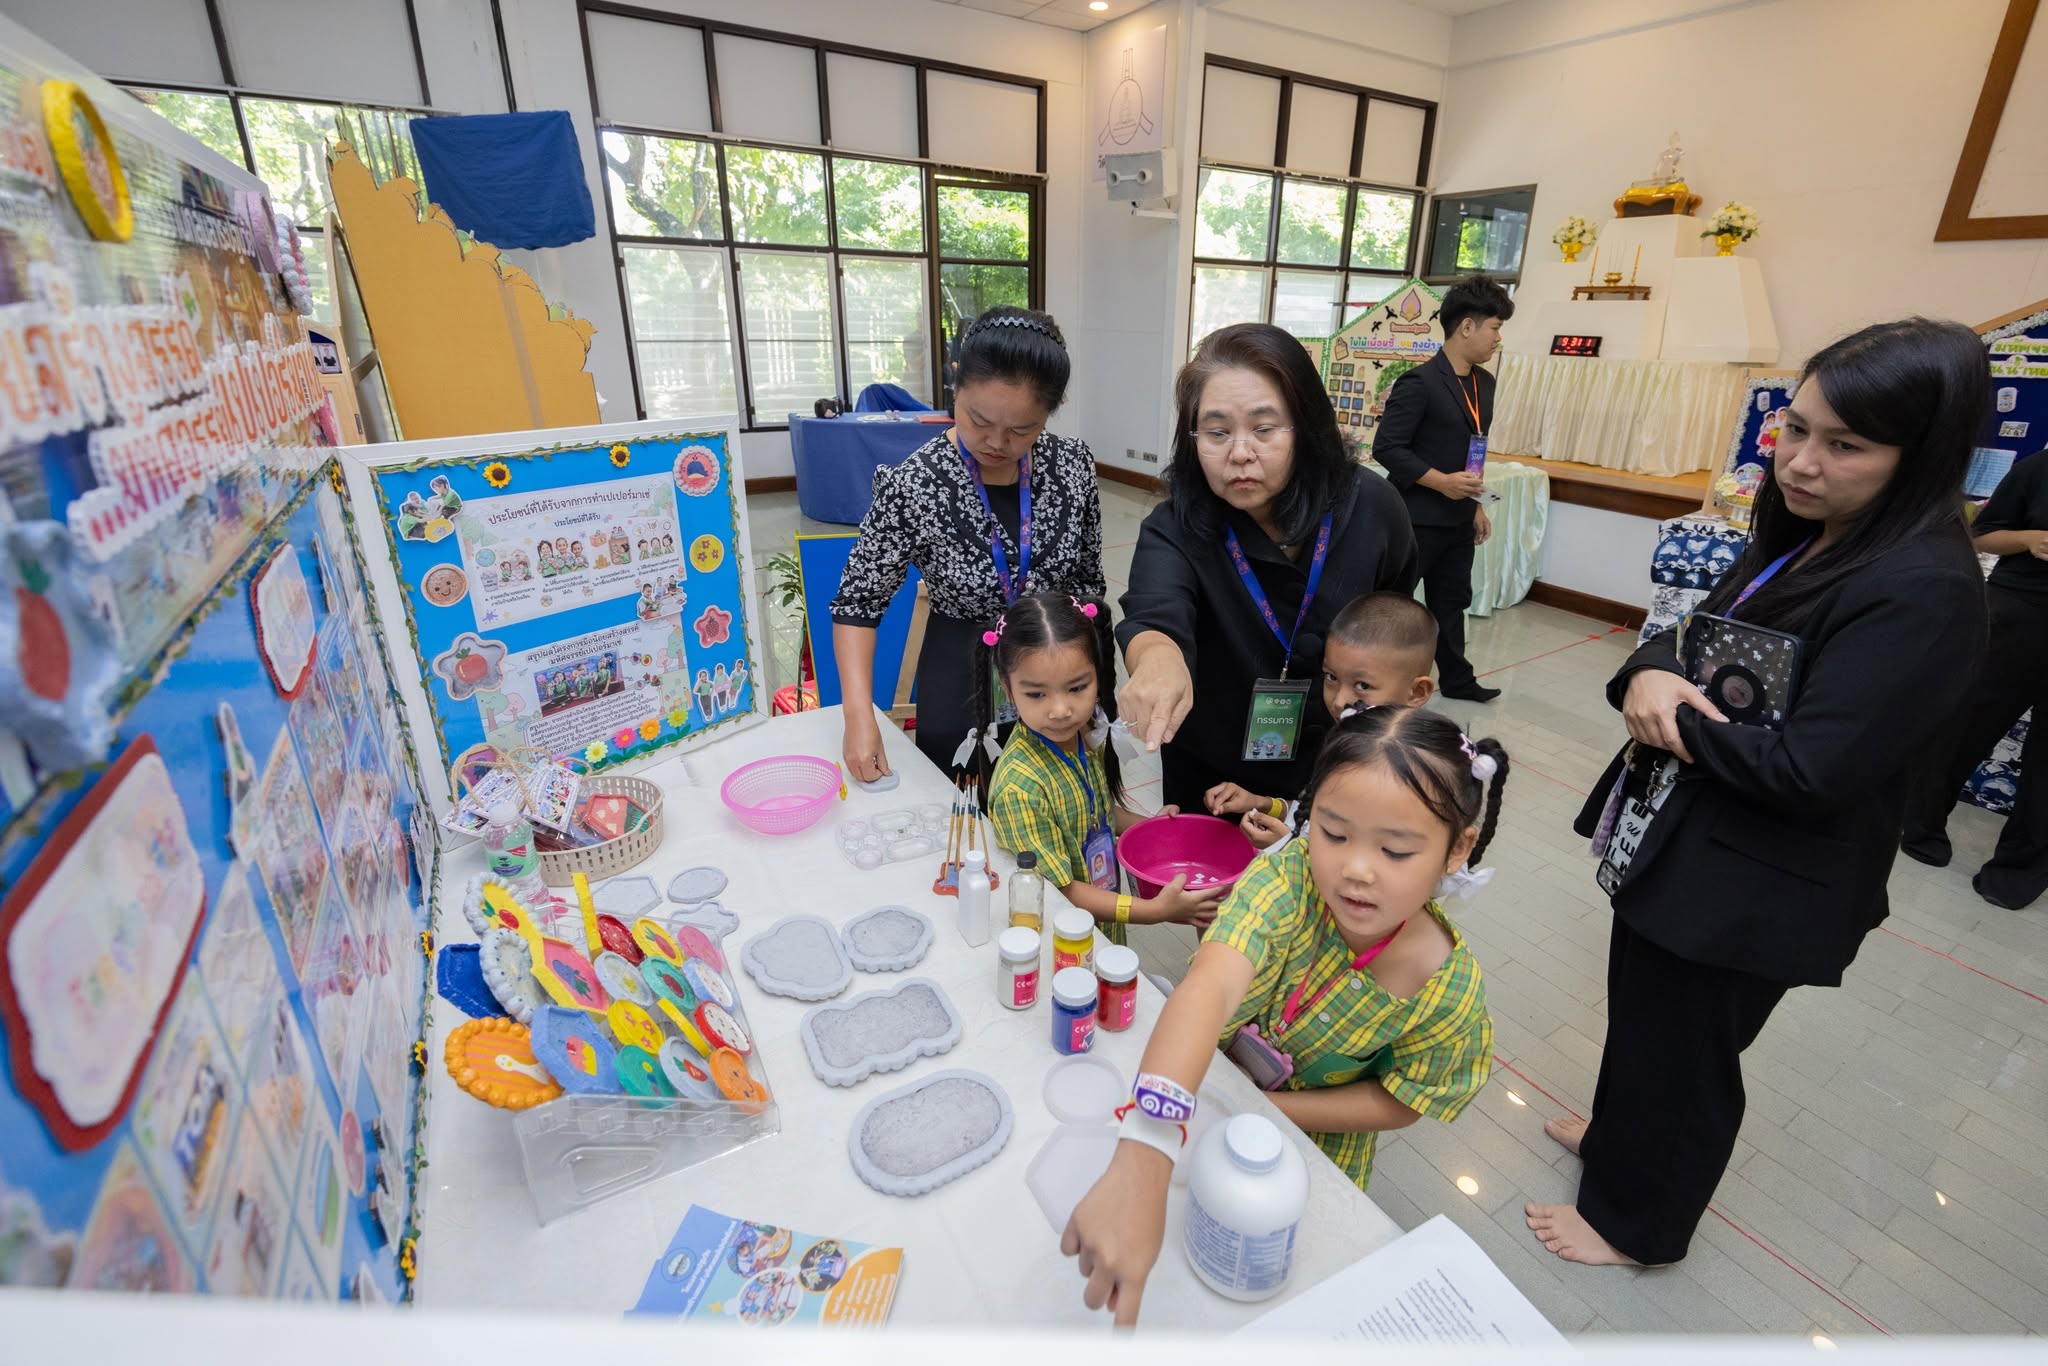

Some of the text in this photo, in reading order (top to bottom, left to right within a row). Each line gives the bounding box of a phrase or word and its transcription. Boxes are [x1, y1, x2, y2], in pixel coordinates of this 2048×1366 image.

[488, 488, 650, 525] ประโยชน์ที่ได้รับจากการทำเปเปอร์มาเช่
[554, 512, 601, 527] ประโยชน์ที่ได้รับ
[1256, 717, 1294, 725] กรรมการ
